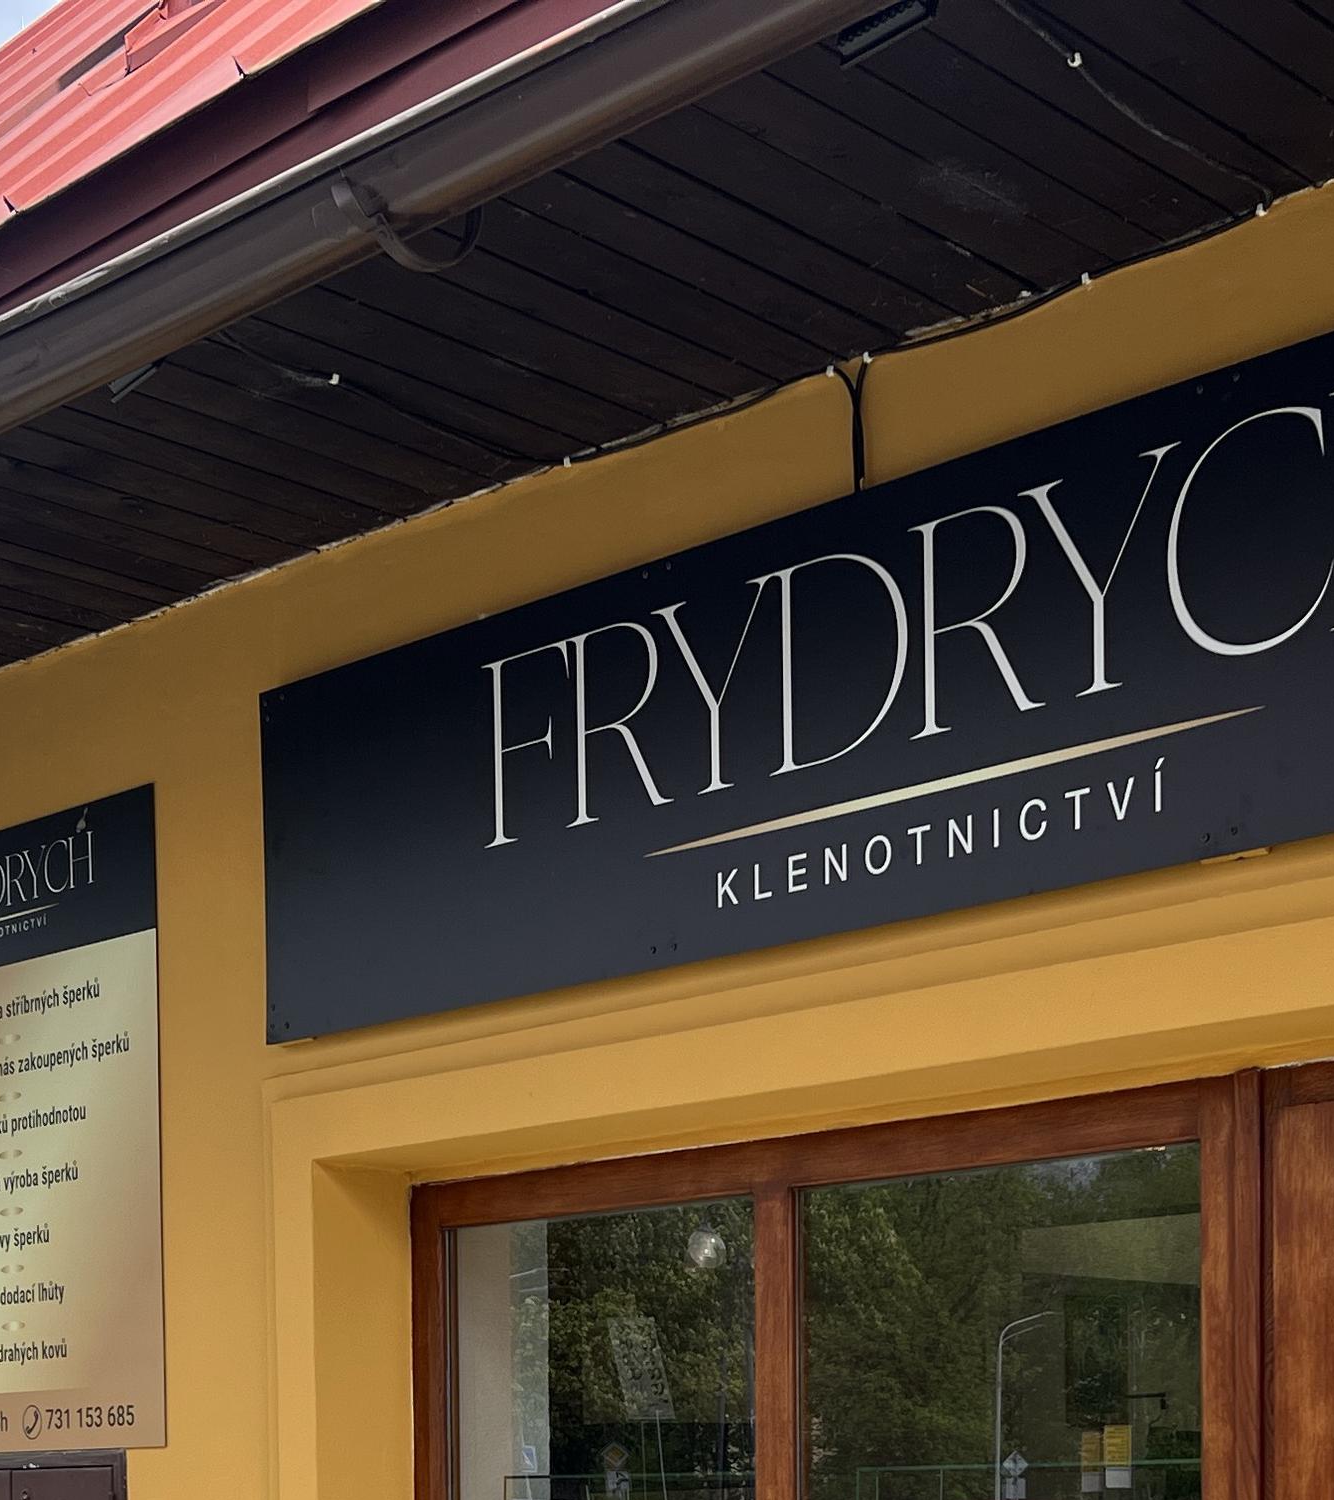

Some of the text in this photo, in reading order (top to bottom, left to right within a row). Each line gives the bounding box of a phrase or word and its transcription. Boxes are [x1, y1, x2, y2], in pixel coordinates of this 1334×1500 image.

[715, 756, 1169, 909] KLENOTNICTVÍ
[6, 987, 59, 1018] stříbrných
[63, 977, 100, 1008] šperků
[18, 1041, 88, 1073] zakoupených
[91, 1031, 130, 1062] šperků
[11, 1105, 86, 1137] protihodnotou
[3, 1166, 39, 1195] výroba
[41, 1160, 79, 1189] šperků
[13, 1223, 50, 1251] šperků
[0, 1284, 35, 1306] dodací
[38, 1281, 65, 1305] lhůty
[42, 1338, 67, 1360] kovů
[45, 1408, 71, 1430] 731
[77, 1407, 103, 1429] 153
[107, 1405, 135, 1427] 685
